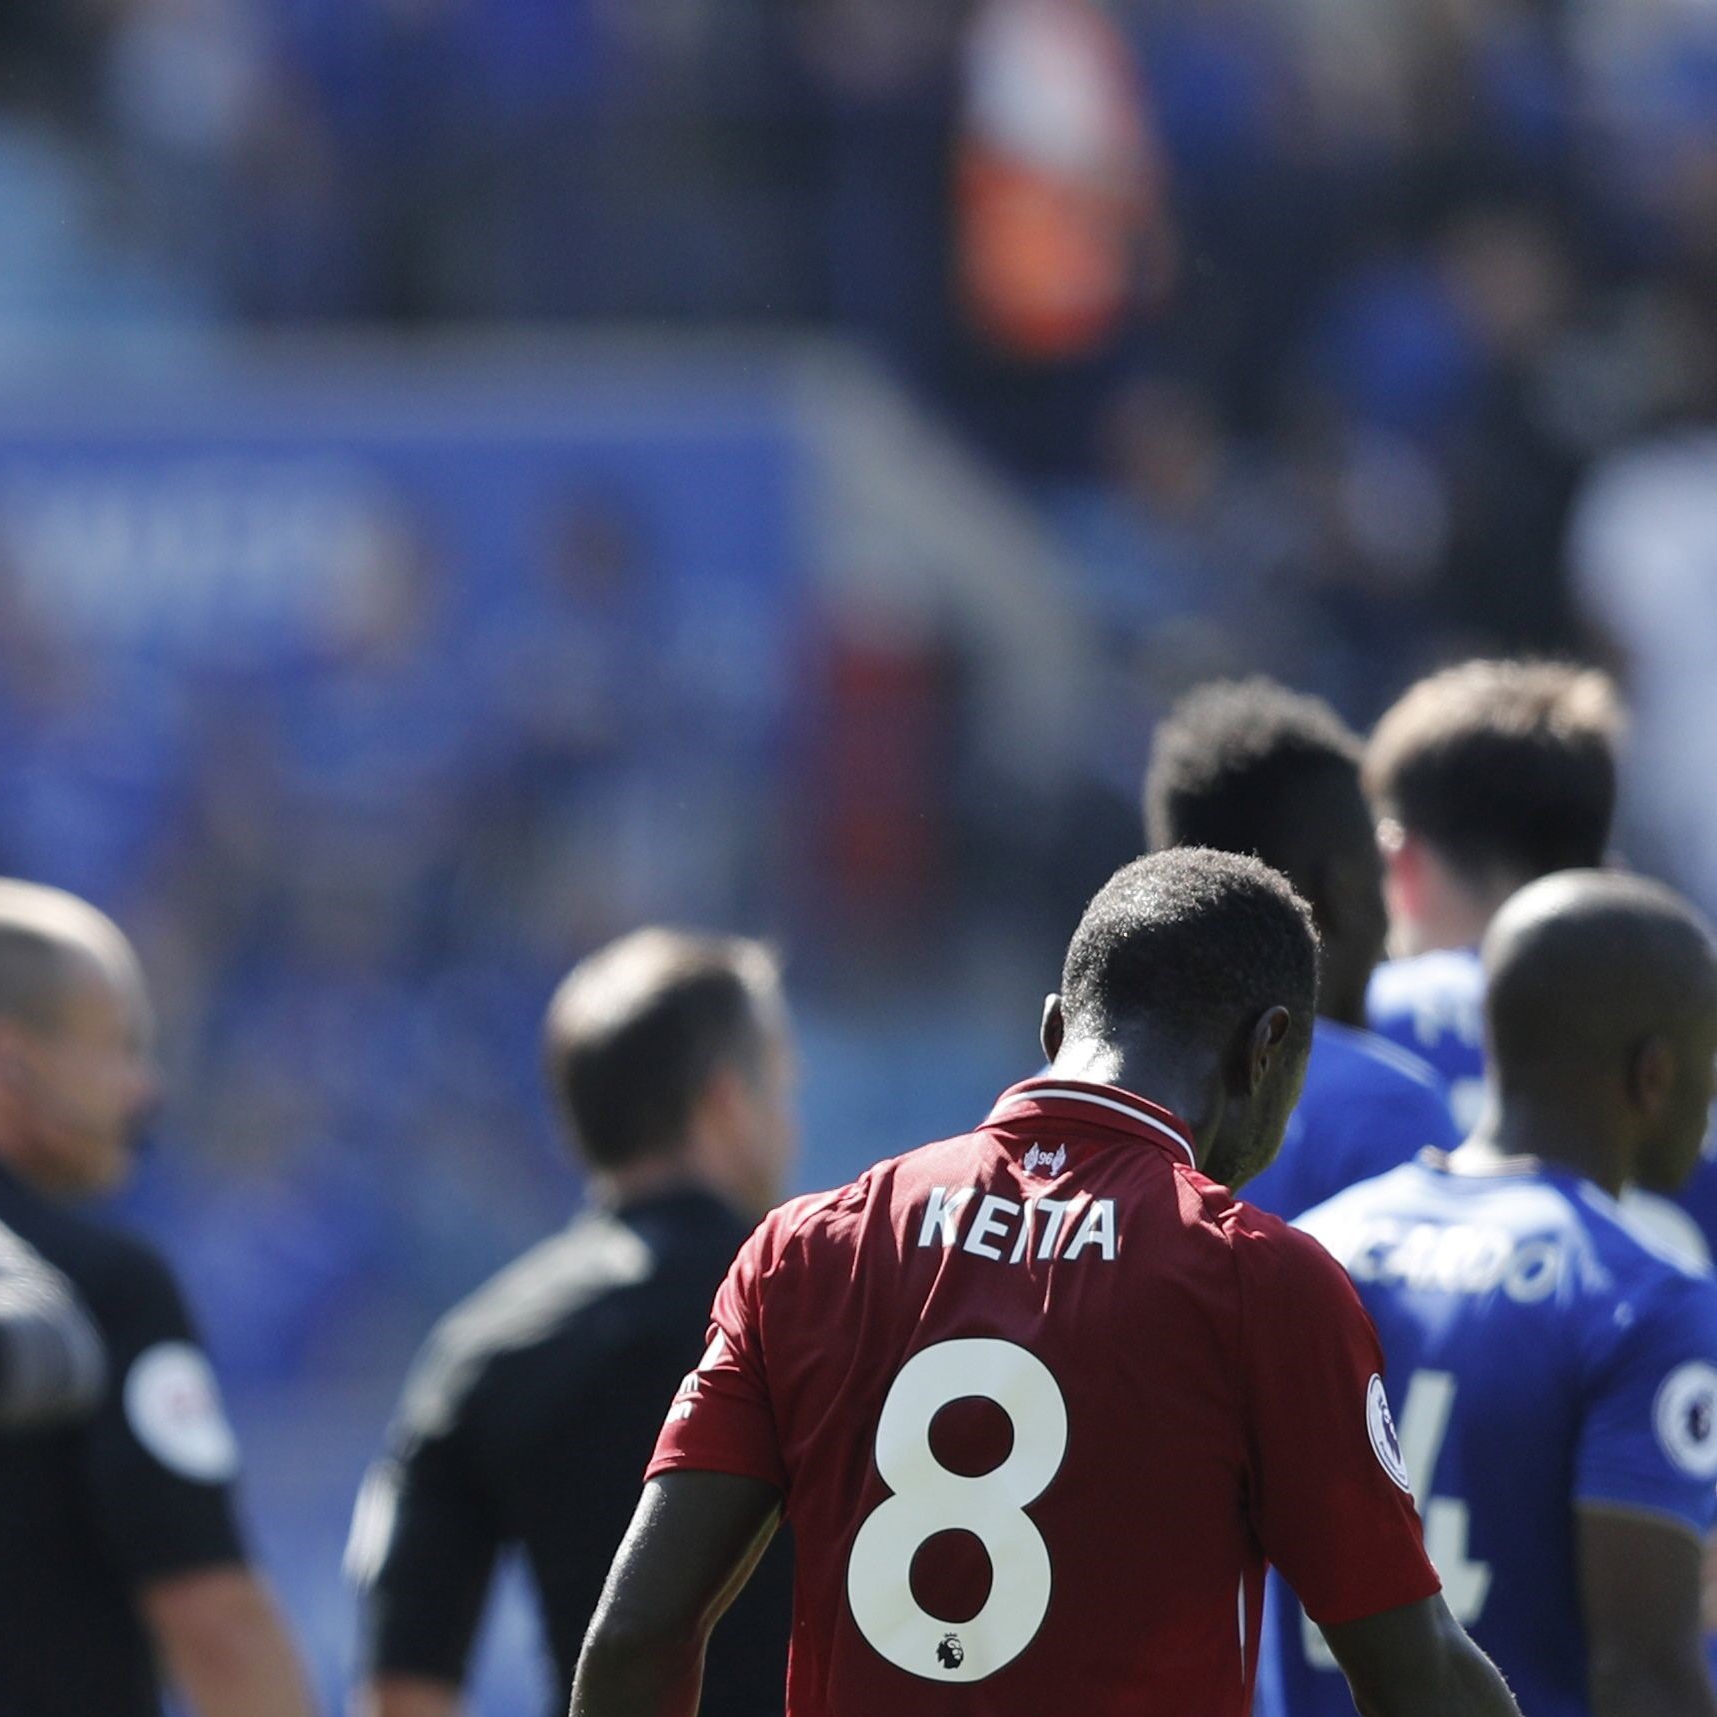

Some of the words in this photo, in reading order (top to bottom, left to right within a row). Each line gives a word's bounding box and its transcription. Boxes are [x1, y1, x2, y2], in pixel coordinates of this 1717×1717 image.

[1037, 1152, 1054, 1165] 96
[918, 1186, 1116, 1264] KEITA
[847, 1338, 1068, 1683] 8
